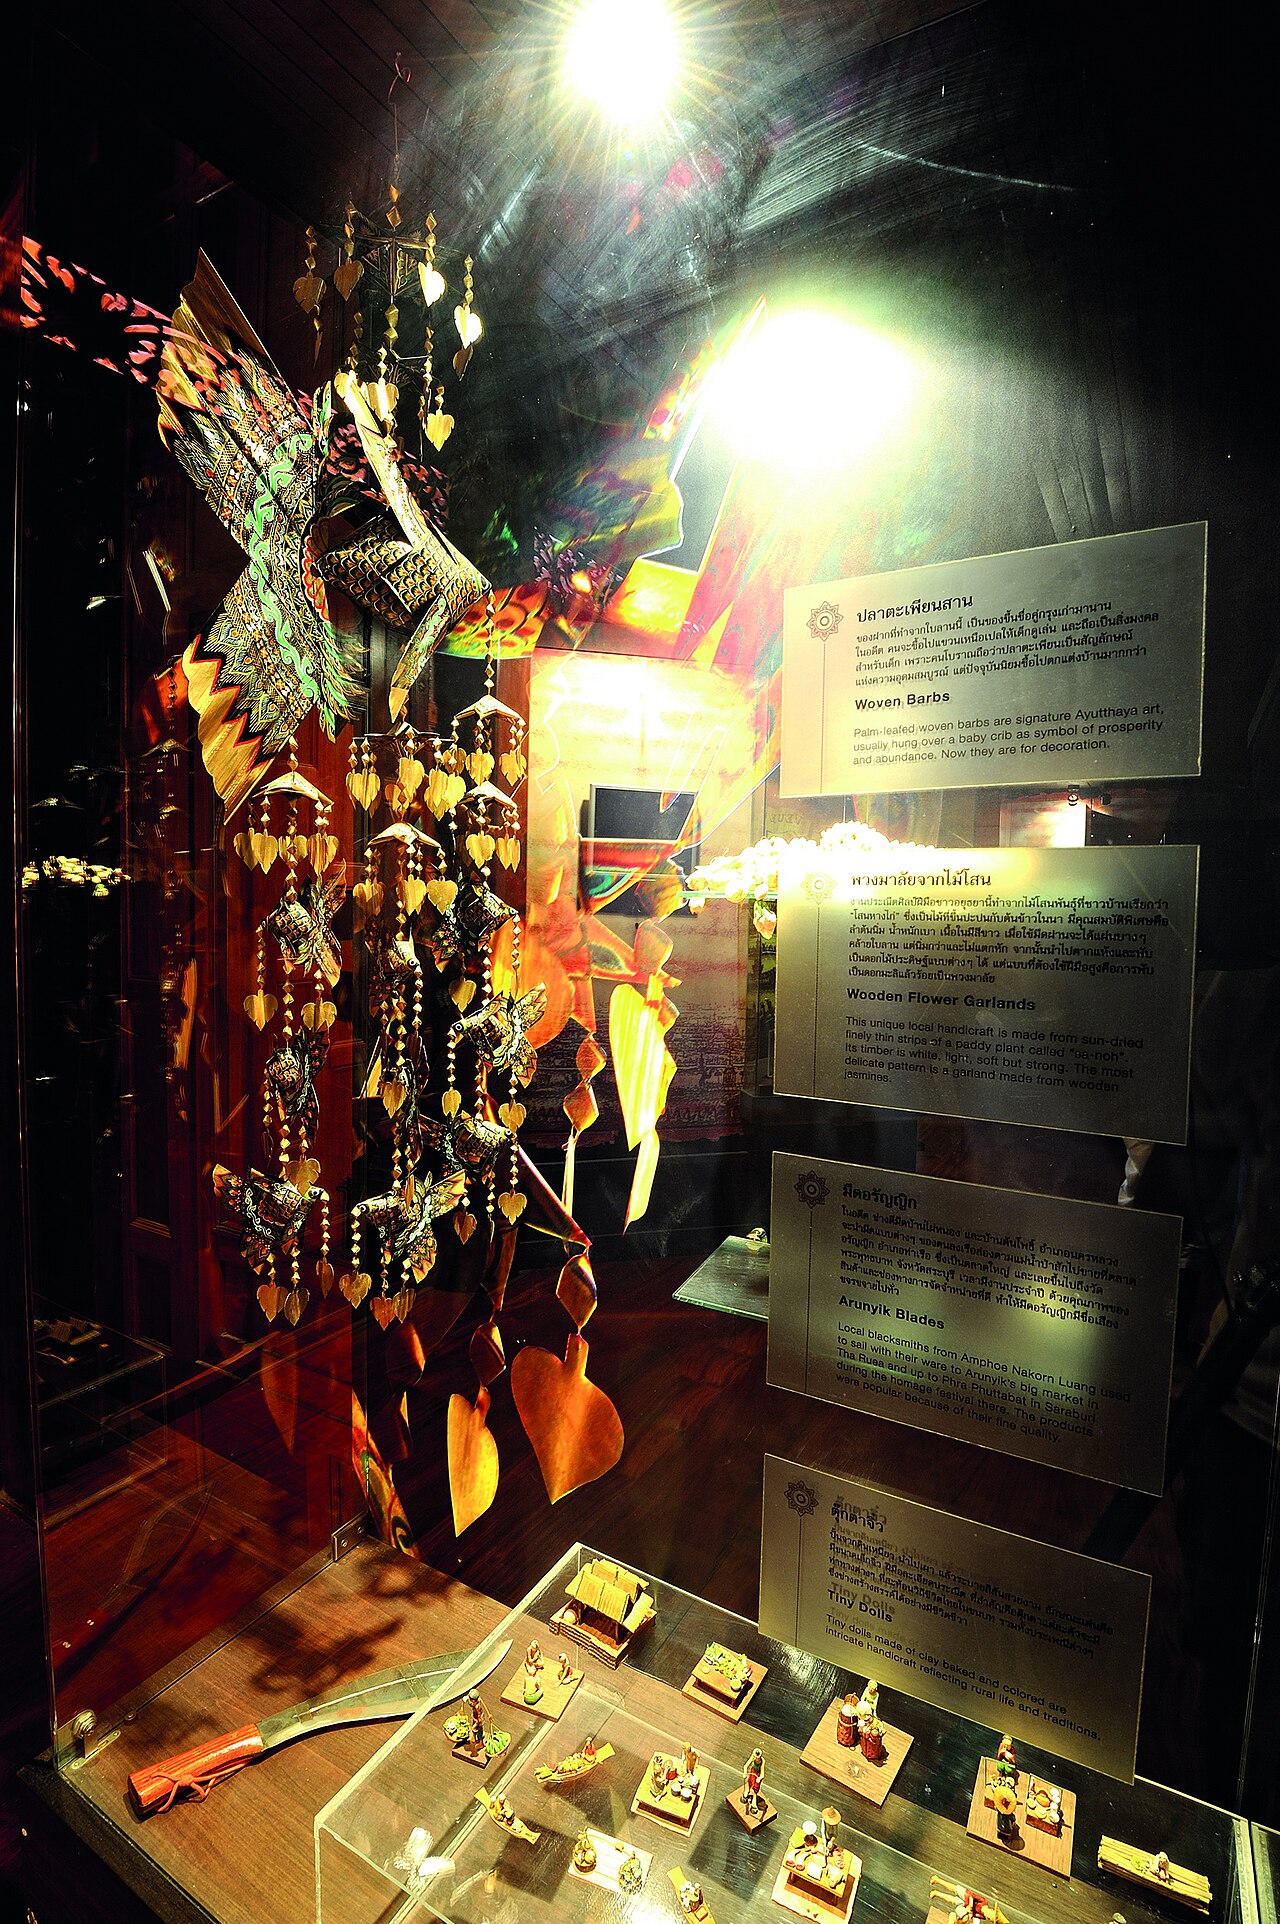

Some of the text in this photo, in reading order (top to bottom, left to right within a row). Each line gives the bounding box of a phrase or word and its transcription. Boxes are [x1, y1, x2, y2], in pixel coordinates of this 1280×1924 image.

[856, 595, 973, 623] ปลาตะเพียนสาน
[855, 645, 884, 658] ในอดีต
[855, 657, 900, 672] สำหรับเด็ก
[855, 691, 950, 710] Woven Barbs
[918, 722, 953, 732] woven
[957, 717, 989, 729] barbs
[993, 717, 1011, 726] are
[1015, 711, 1070, 726] signature
[1075, 704, 1137, 721] Ayutthaya
[1142, 703, 1164, 716] art,
[853, 719, 1163, 753] usually hung over a baby crib as symbol of prosperity
[853, 738, 1110, 765] and abundance. Now they are for decoration.
[846, 987, 1036, 1011] Wooden Flower Garlands
[845, 1016, 1144, 1049] This unique local handicraft is made from sun-dried
[845, 1029, 872, 1043] finely
[874, 1032, 894, 1042] thin
[897, 1034, 927, 1047] strips
[930, 1037, 942, 1047] of
[945, 1039, 952, 1048] a
[955, 1040, 992, 1053] paddy
[995, 1042, 1025, 1054] plant
[1028, 1045, 1065, 1058] called
[844, 1056, 1119, 1092] delicate pattern is a garland made from wooden
[844, 1069, 891, 1084] jasmines.
[845, 1042, 1134, 1079] Its timber is white, light, soft but strong. The most
[838, 1295, 945, 1330] Arunyik Blades
[837, 1335, 848, 1346] to
[850, 1340, 867, 1351] sail
[870, 1345, 892, 1357] with
[894, 1350, 918, 1364] their
[921, 1358, 948, 1372] ware
[950, 1364, 962, 1375] to
[1020, 1381, 1038, 1397] big
[1042, 1389, 1084, 1407] market
[1087, 1398, 1099, 1410] in
[837, 1346, 856, 1361] Tha
[887, 1362, 907, 1374] and
[910, 1368, 924, 1380] up
[927, 1371, 939, 1383] to
[942, 1374, 967, 1390] Phra
[971, 1382, 1027, 1406] Phuttabat
[1030, 1397, 1041, 1409] in
[838, 1321, 1131, 1403] Local blacksmiths from Amphoe Nakorn Luang used
[836, 1361, 1093, 1437] during the homage festival there. The products
[836, 1374, 1061, 1443] were popular because of their fine quality.
[827, 1589, 893, 1623] Tiny Dolls
[826, 1613, 1067, 1715] Tiny dolls made of clay baked and colored are
[825, 1627, 1101, 1741] intricate handicraft reflecting rural life and traditions.
